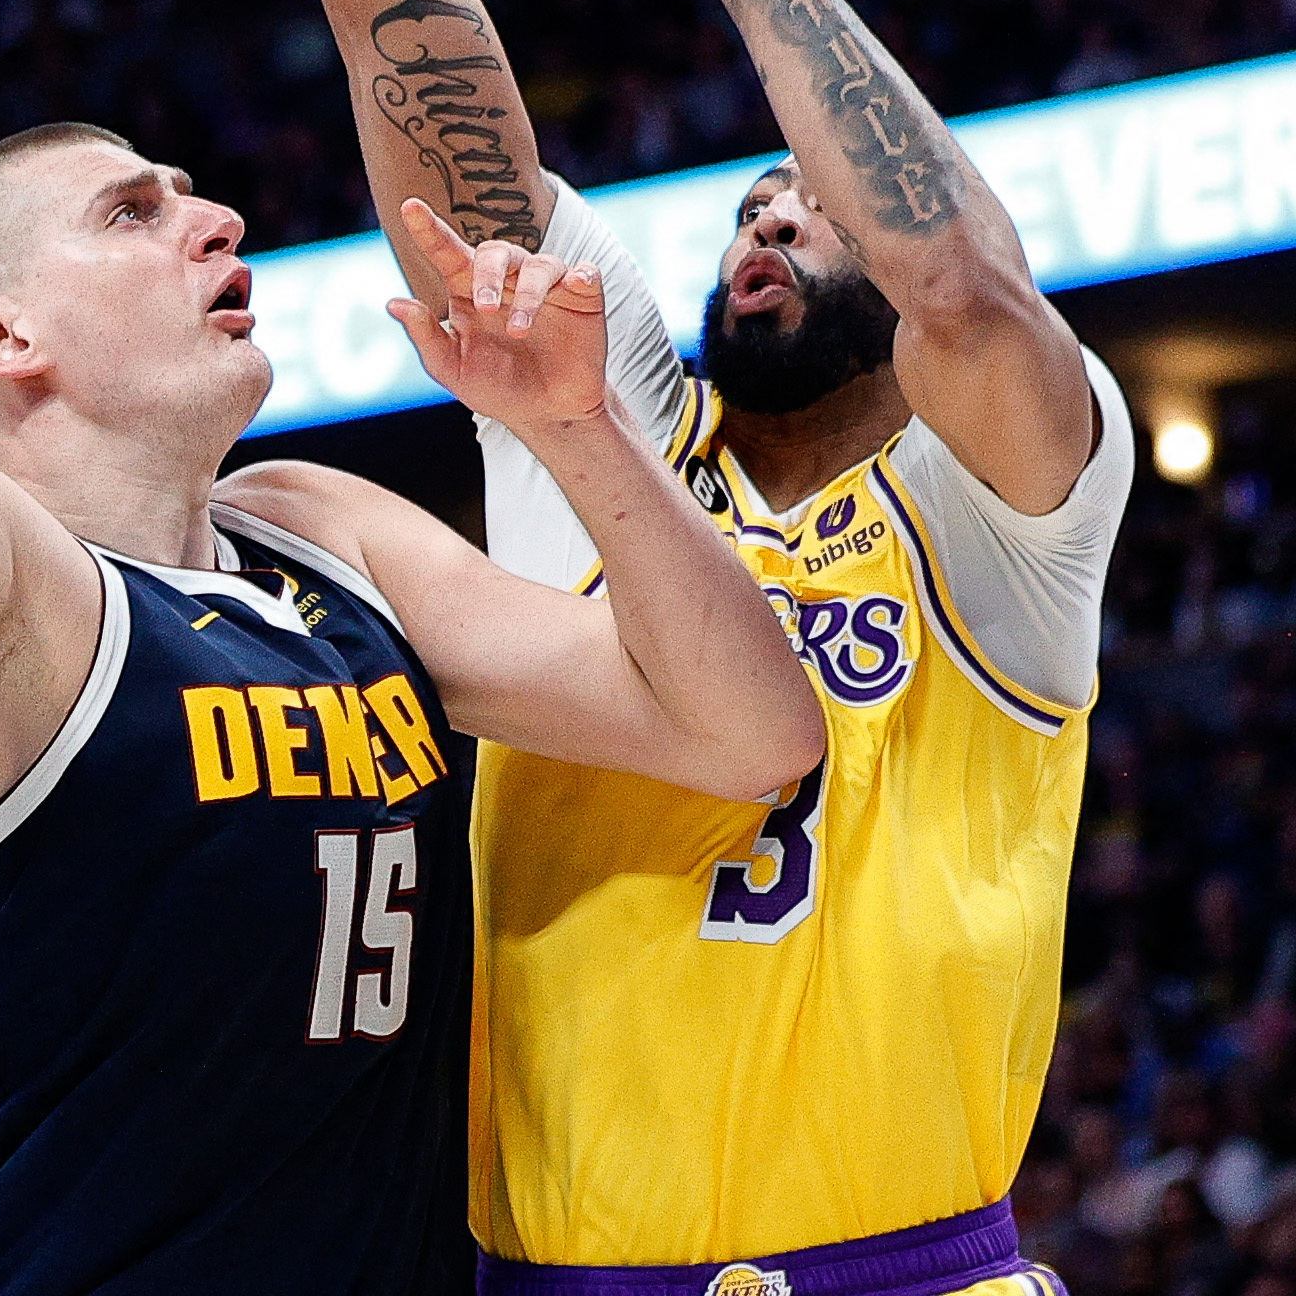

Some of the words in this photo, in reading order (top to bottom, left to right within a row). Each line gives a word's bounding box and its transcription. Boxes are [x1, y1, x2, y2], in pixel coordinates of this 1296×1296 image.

[804, 521, 886, 575] bibigo
[179, 671, 449, 807] DENER
[306, 821, 417, 1045] 15
